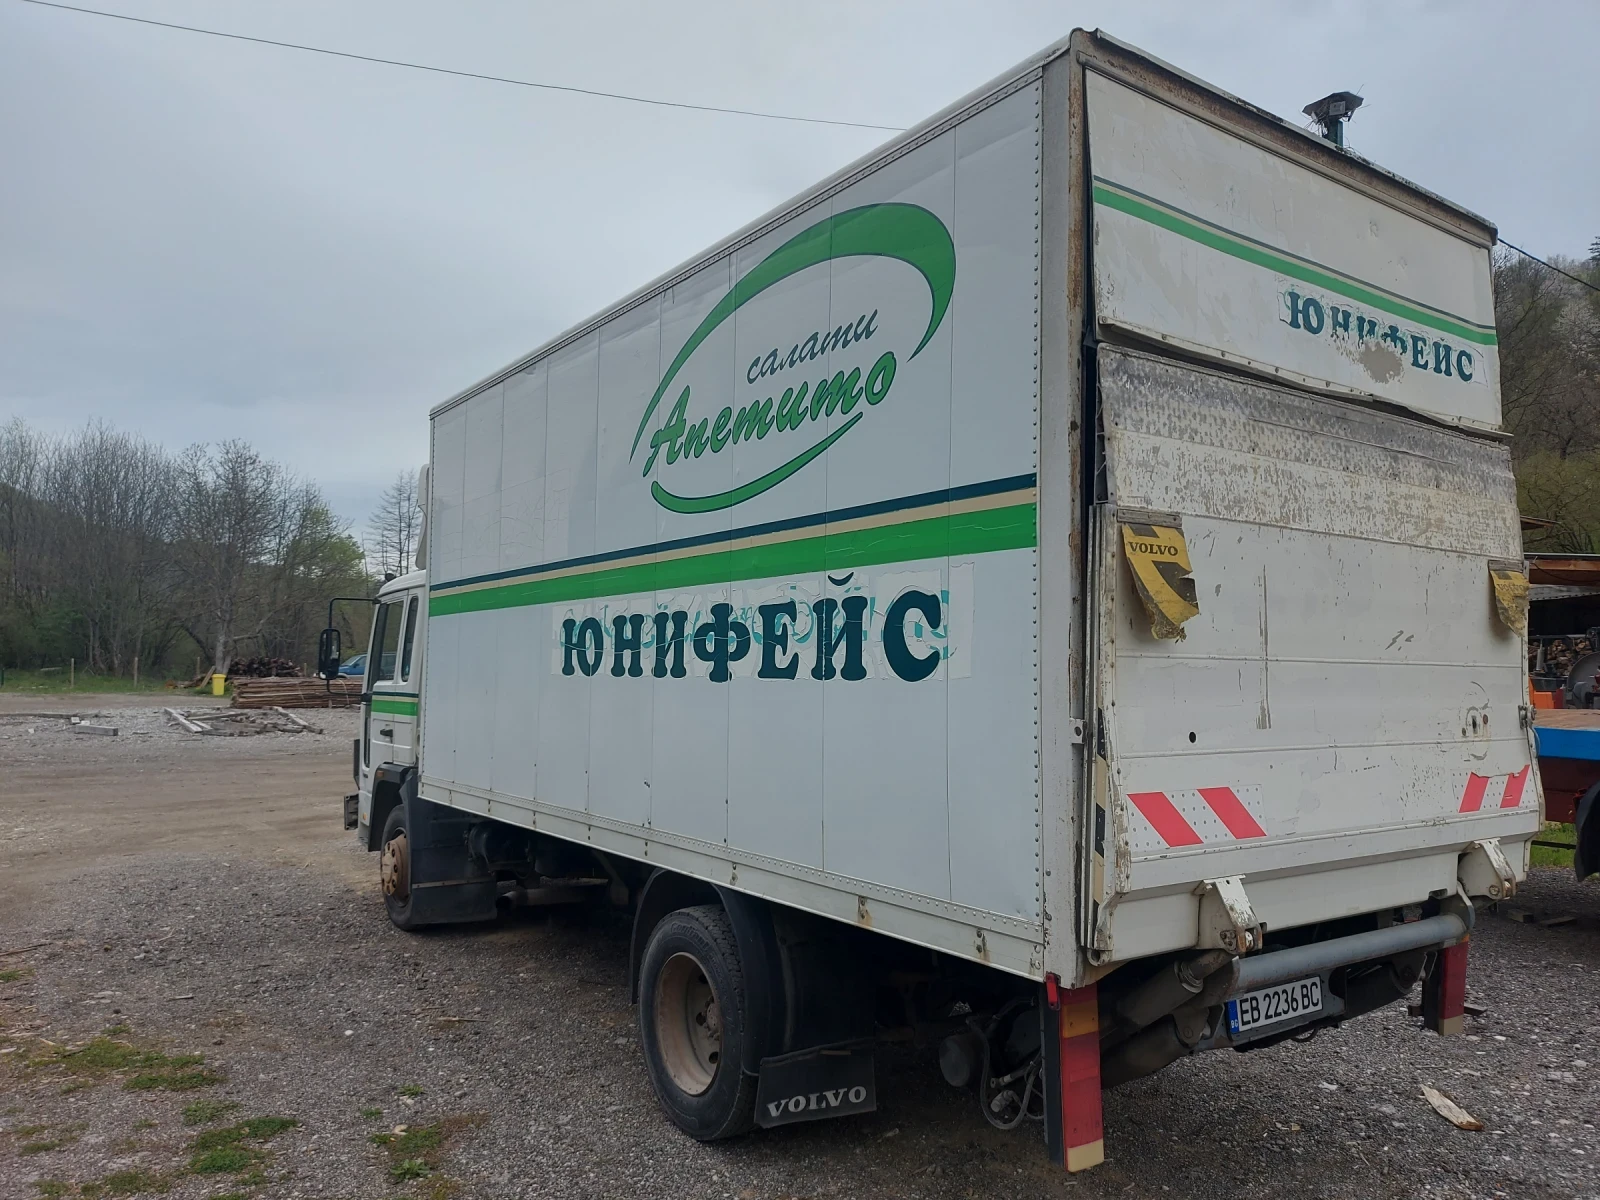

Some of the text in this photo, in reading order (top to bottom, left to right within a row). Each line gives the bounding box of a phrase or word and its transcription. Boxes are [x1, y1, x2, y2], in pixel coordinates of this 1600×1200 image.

[747, 309, 878, 384] салати
[643, 351, 897, 477] Апетито
[1128, 541, 1178, 556] VOLVO
[561, 572, 942, 683] ЮНИФЕЙС
[1239, 981, 1320, 1026] EB 2236 BC
[766, 1086, 867, 1117] VOLVO
